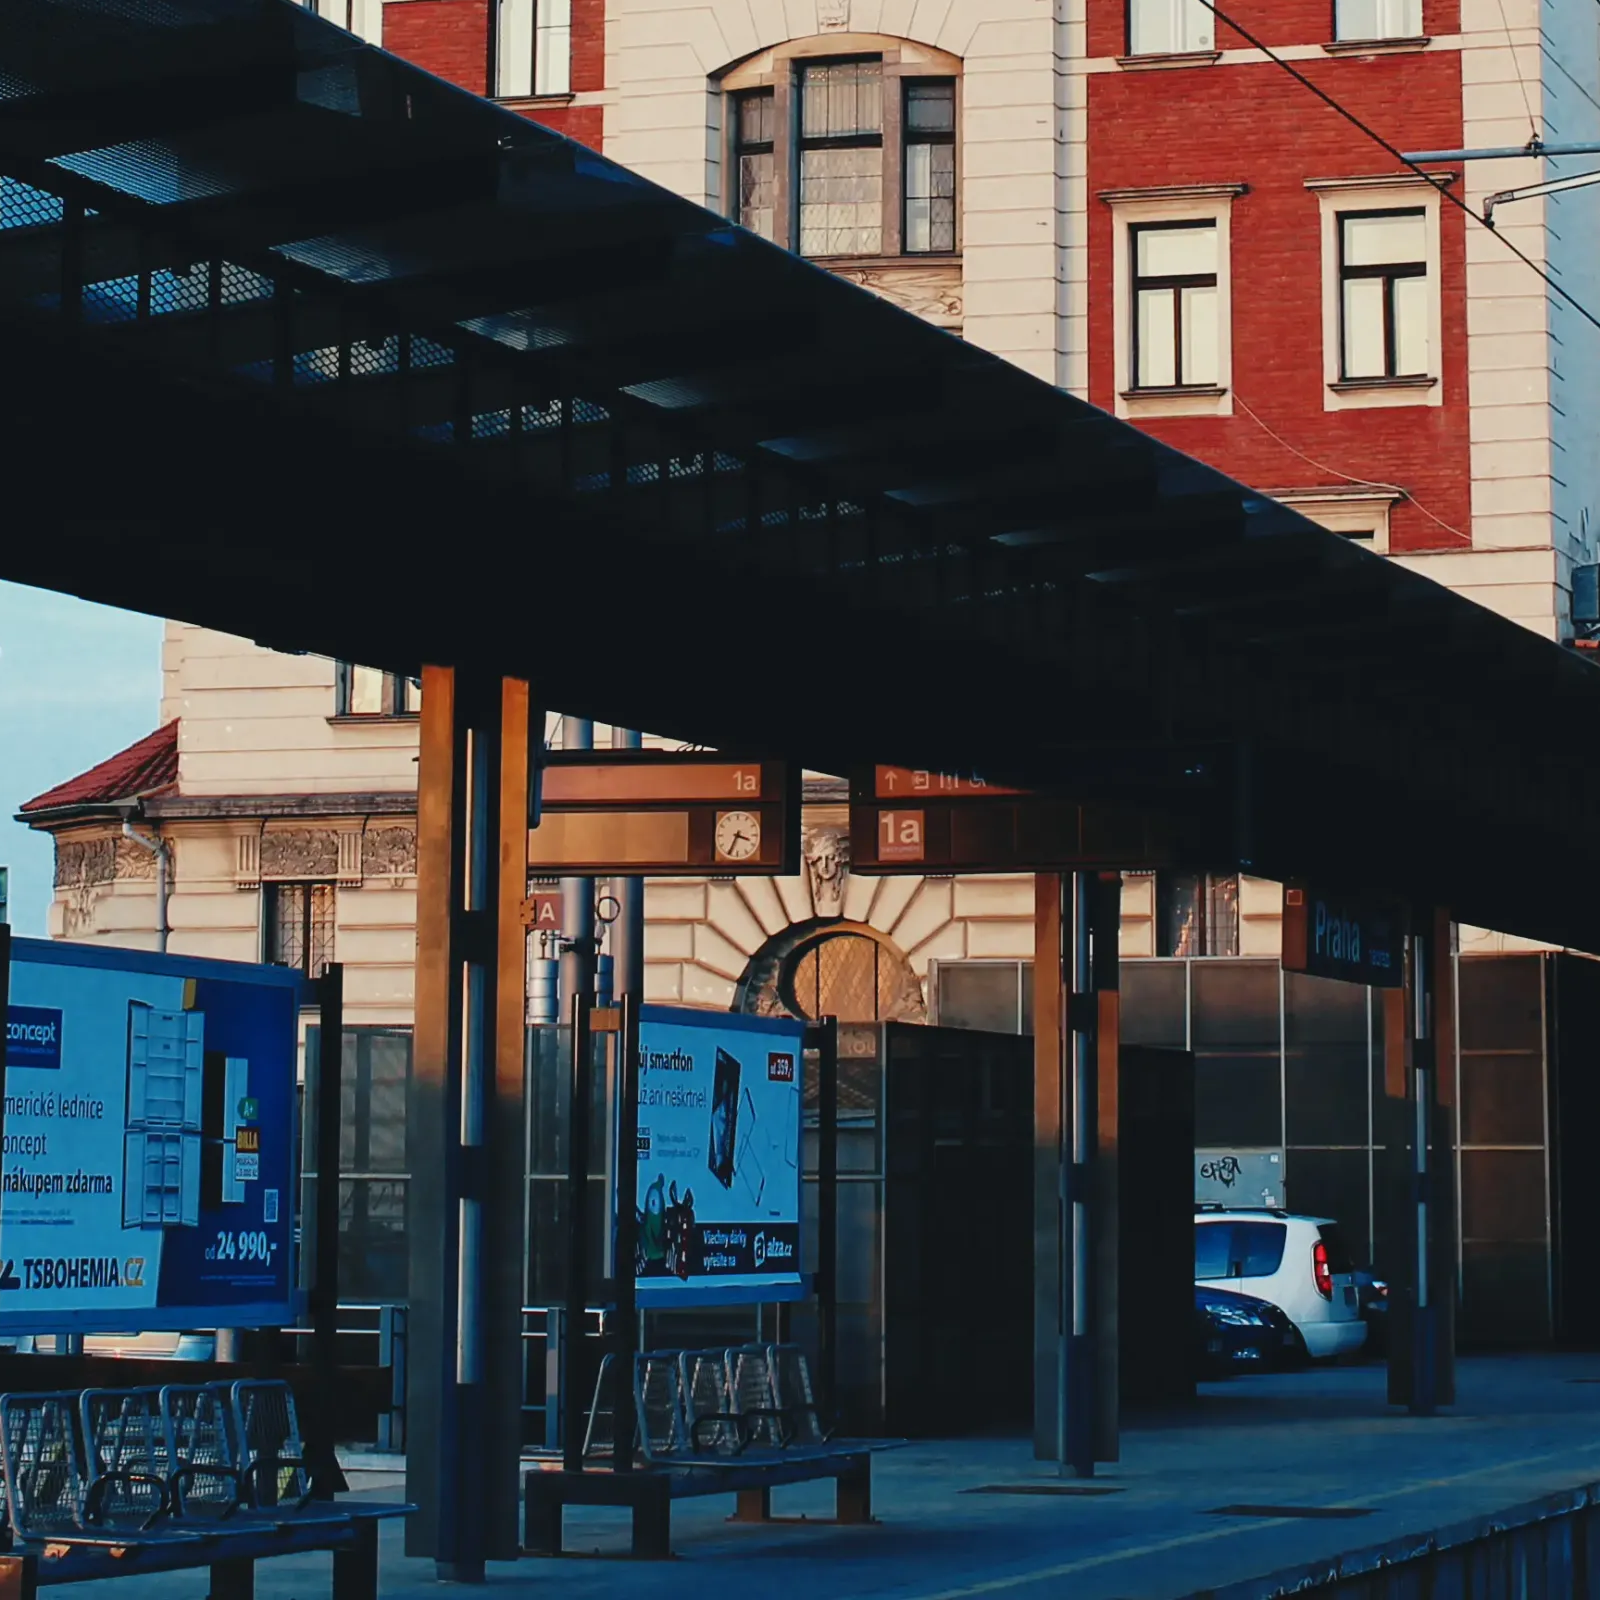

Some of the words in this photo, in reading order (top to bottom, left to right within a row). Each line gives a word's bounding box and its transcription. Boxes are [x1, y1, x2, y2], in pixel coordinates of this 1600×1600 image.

[733, 770, 757, 791] 1a
[881, 812, 921, 844] 1a
[539, 901, 556, 921] A
[649, 1047, 694, 1072] smartfon
[58, 1092, 104, 1119] lednice
[3, 1164, 64, 1200] nákupem
[66, 1168, 113, 1194] zdarma
[217, 1230, 236, 1261] 24
